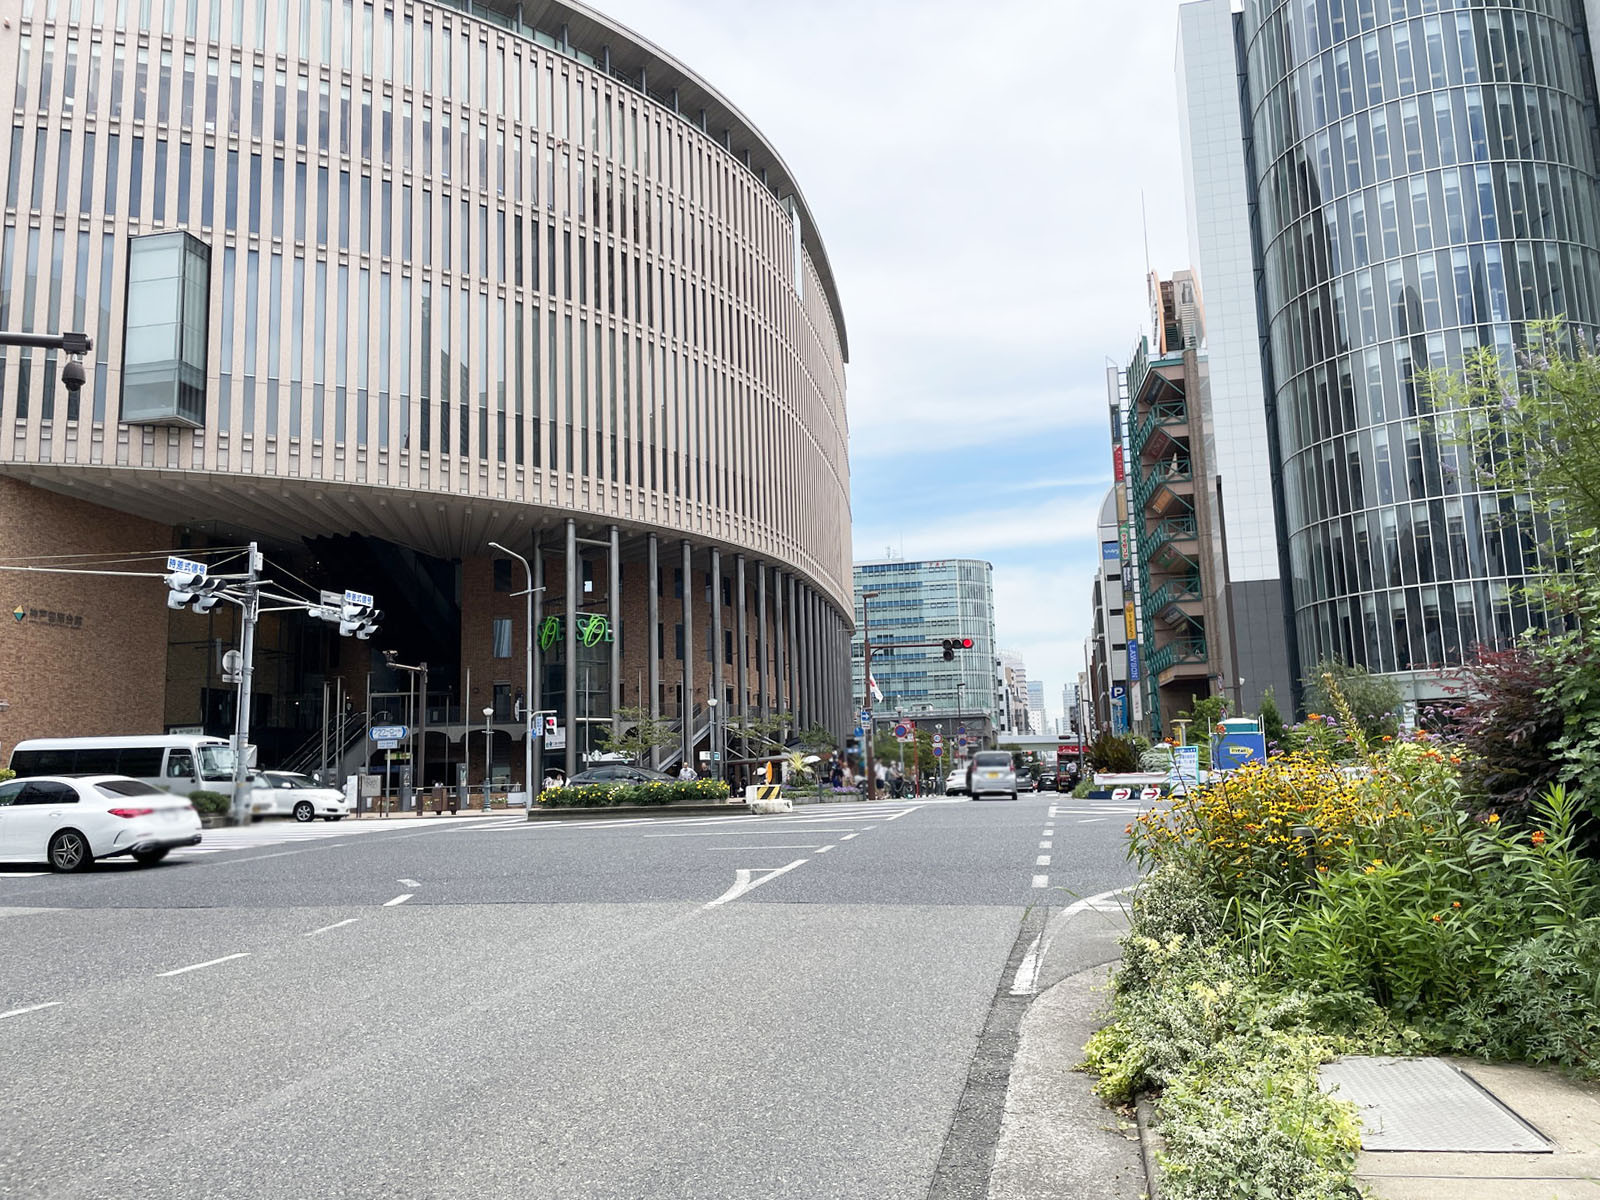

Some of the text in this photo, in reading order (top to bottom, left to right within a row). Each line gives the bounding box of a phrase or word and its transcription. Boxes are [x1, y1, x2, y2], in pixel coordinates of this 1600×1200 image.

[169, 558, 206, 575] 時差式信号
[1129, 644, 1138, 679] LAWSON
[1114, 687, 1124, 697] P
